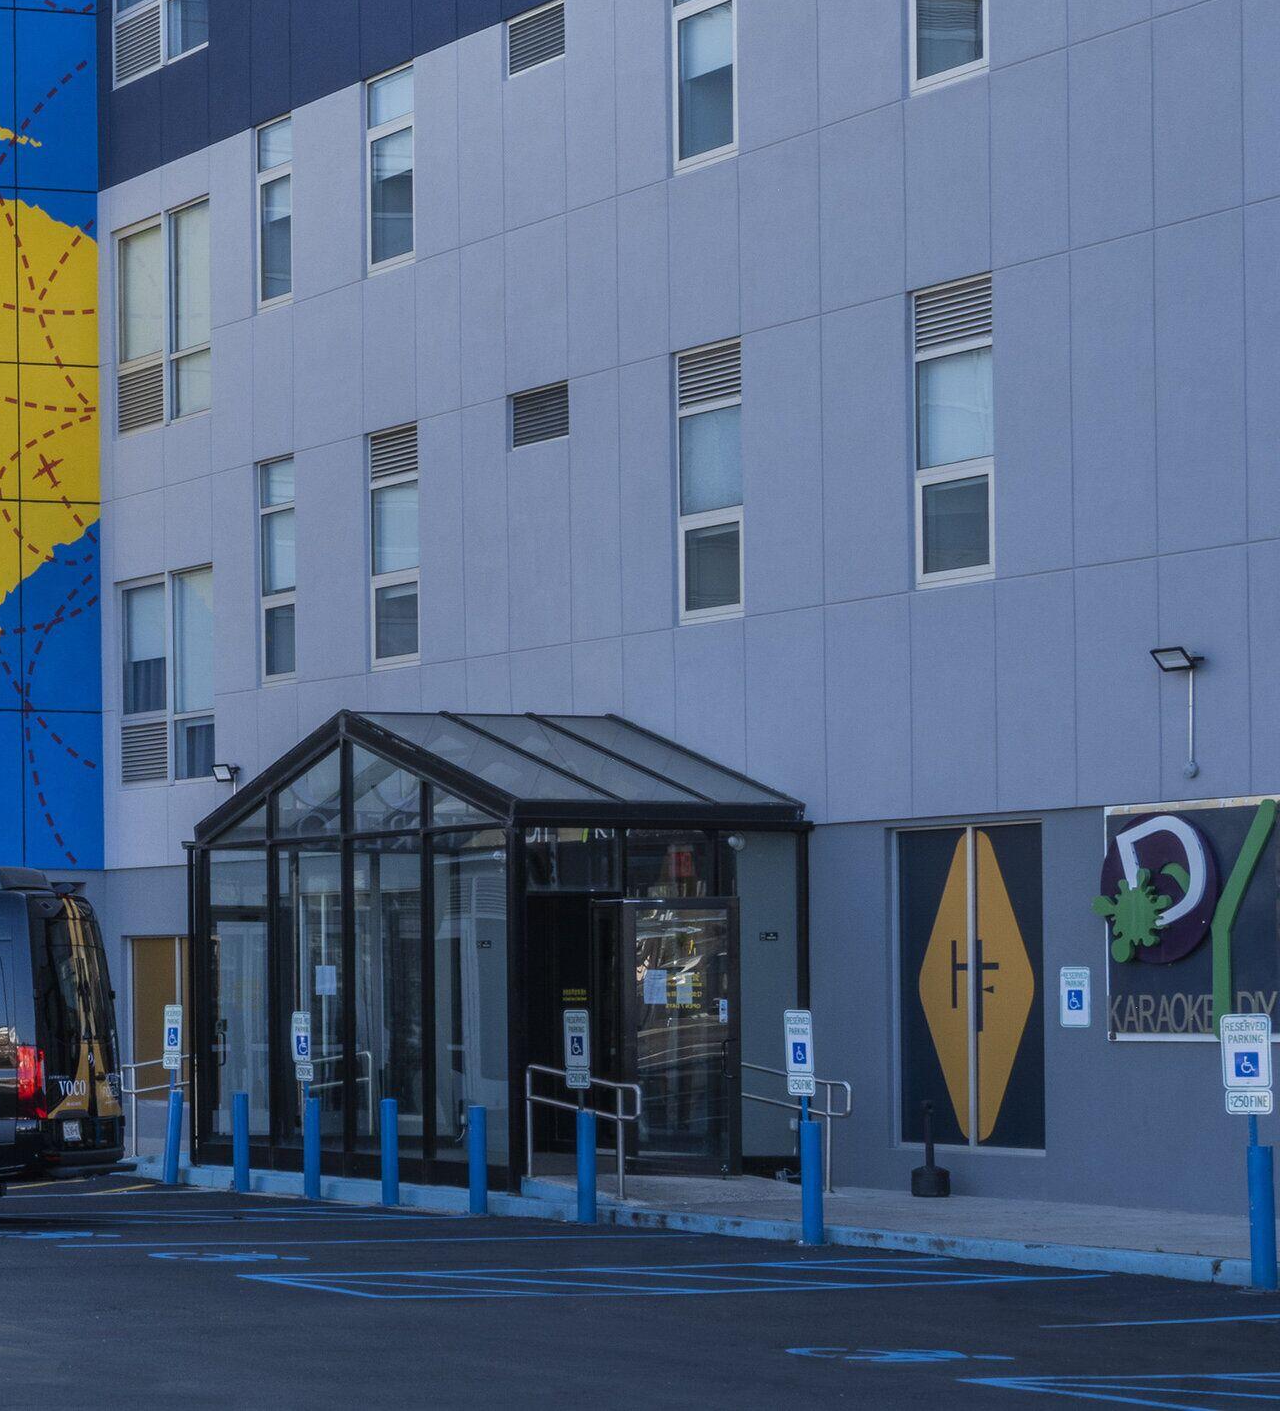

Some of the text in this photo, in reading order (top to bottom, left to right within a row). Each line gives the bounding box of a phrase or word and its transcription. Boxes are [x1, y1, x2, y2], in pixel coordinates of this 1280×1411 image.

[1061, 971, 1089, 979] RESERVED
[1109, 992, 1214, 1033] KARAOKE
[1224, 1020, 1266, 1032] RESERVED
[1227, 1033, 1264, 1044] PARKING
[1249, 1096, 1269, 1108] FINE
